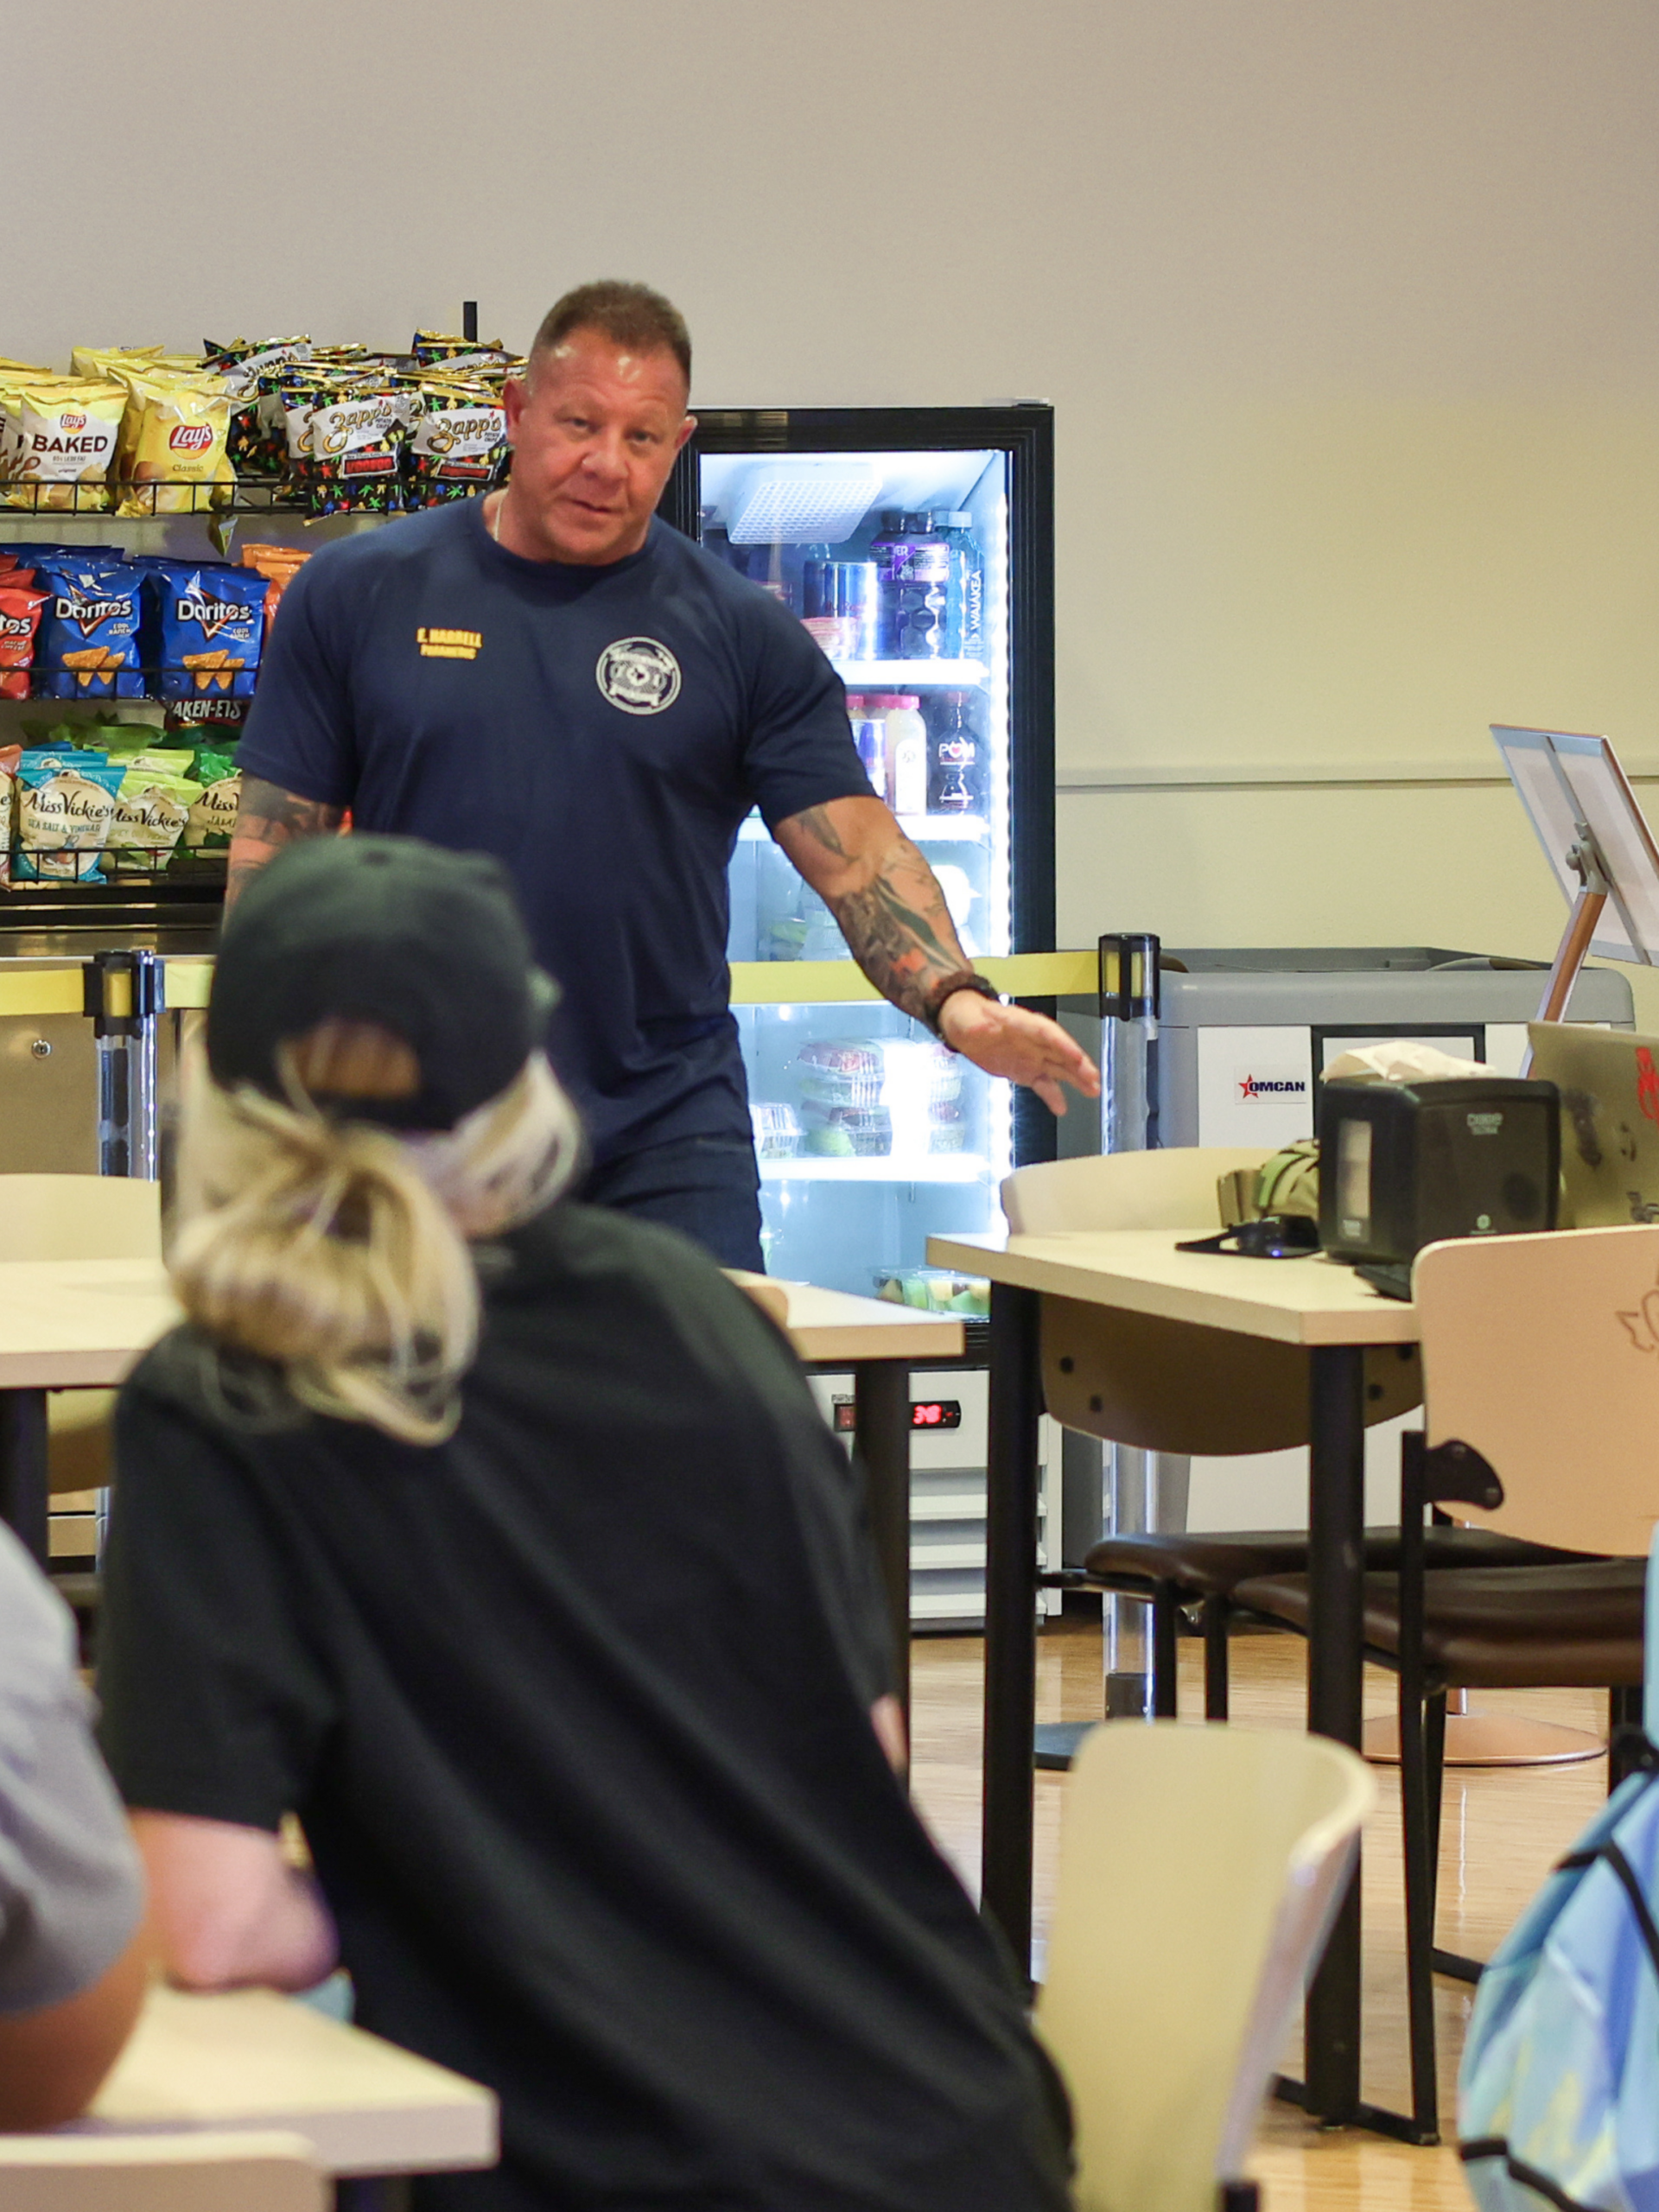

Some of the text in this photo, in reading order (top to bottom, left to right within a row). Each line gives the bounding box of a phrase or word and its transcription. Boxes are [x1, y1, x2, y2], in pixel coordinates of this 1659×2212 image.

[31, 433, 108, 454] BAKED
[55, 597, 132, 620] Doritos
[177, 599, 251, 621] Doritos
[173, 700, 241, 719] AKEN-ETS
[1249, 1081, 1306, 1092] OMCAN
